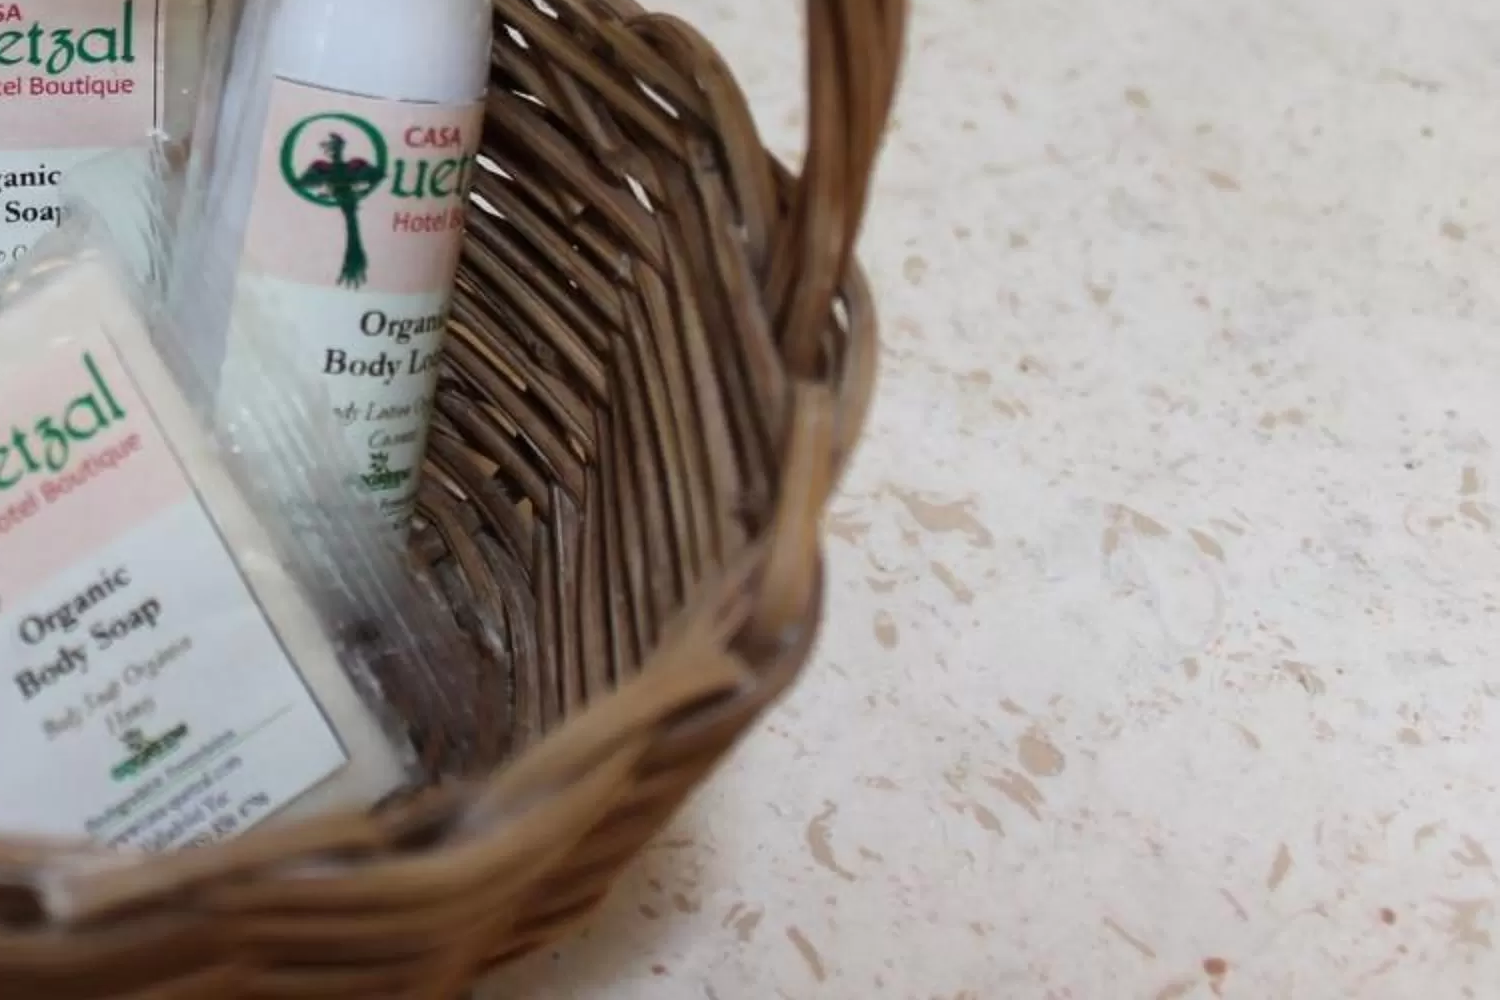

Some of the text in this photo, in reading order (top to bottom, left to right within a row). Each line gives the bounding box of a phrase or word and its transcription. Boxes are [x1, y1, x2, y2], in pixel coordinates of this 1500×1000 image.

[30, 75, 135, 99] Boutique
[404, 126, 461, 148] CASA
[323, 348, 402, 386] Body
[40, 433, 142, 504] Boutique
[19, 563, 132, 645] Organic
[13, 598, 162, 701] Body Soap
